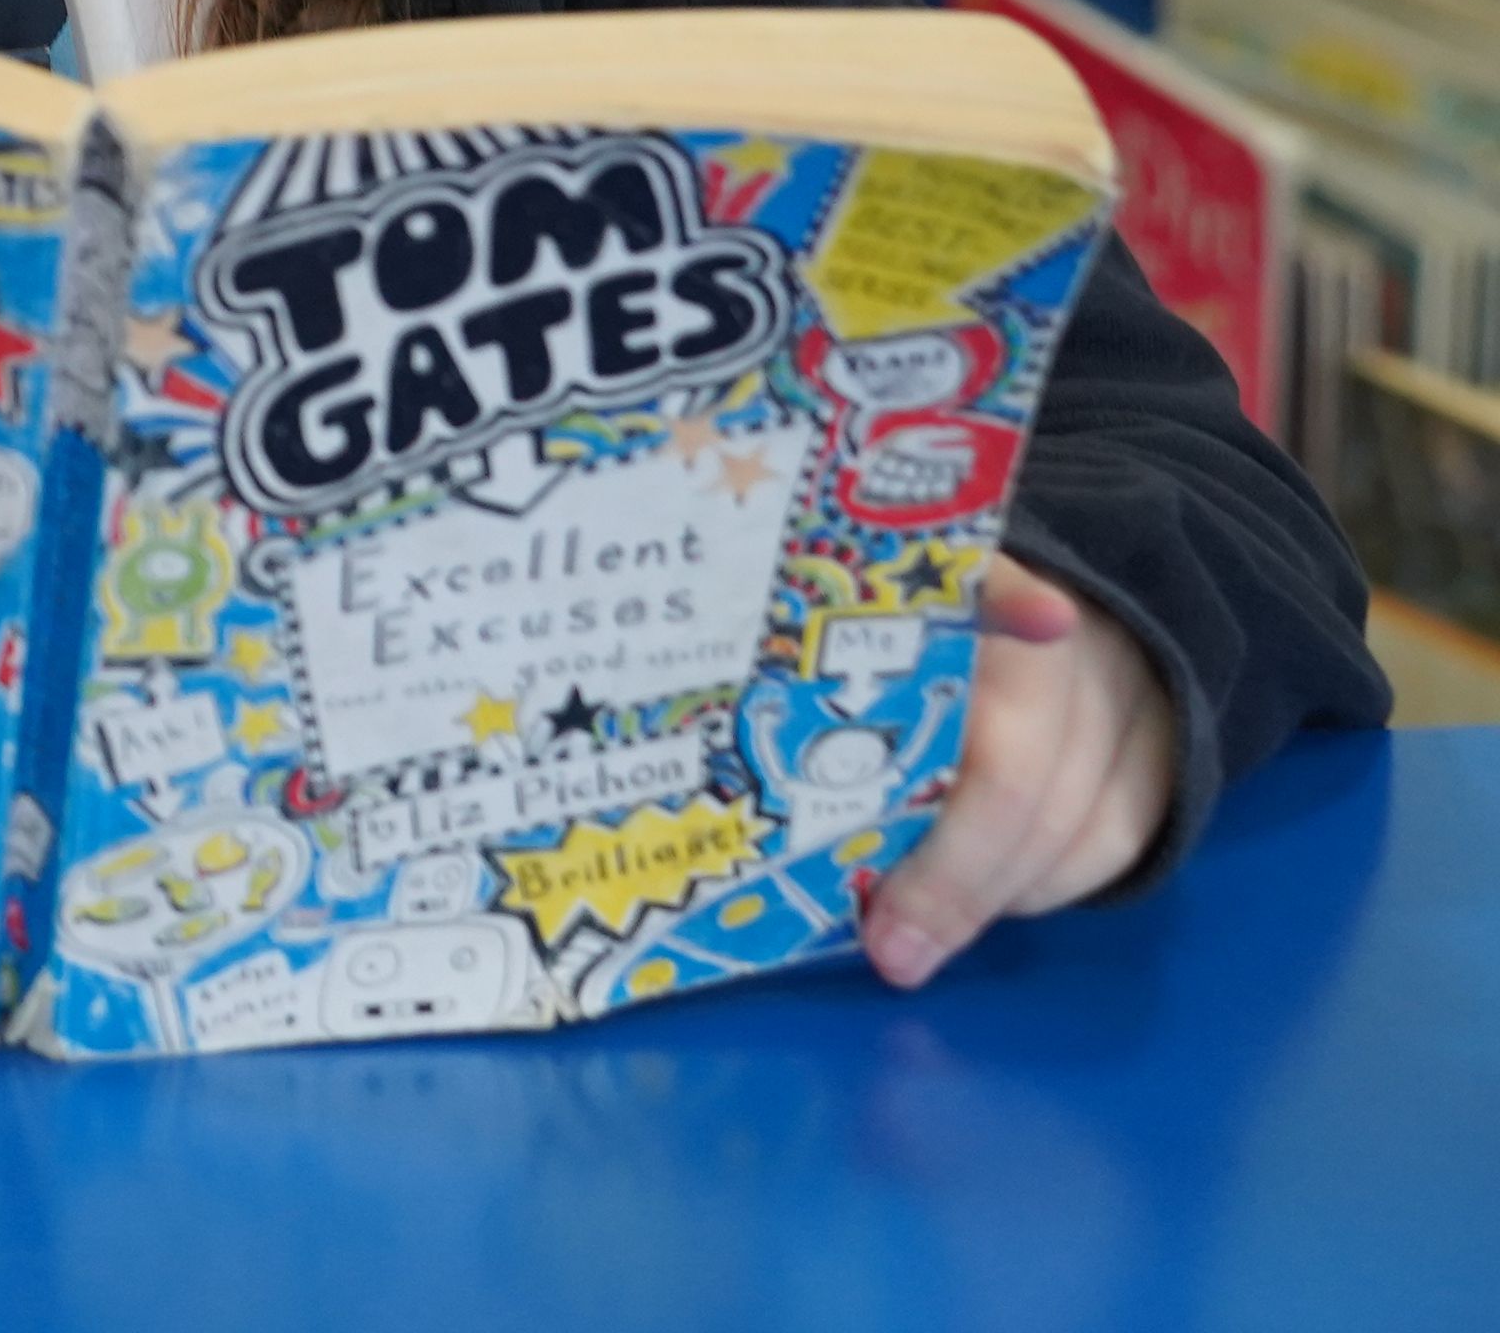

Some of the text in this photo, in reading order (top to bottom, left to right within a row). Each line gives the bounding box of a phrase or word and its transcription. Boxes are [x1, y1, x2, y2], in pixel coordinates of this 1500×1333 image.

[231, 157, 667, 354] TOM
[258, 251, 762, 491] GATES
[340, 521, 705, 615] Excellent
[372, 585, 696, 669] Excuses
[512, 639, 628, 696] good
[407, 799, 486, 841] Liz
[512, 756, 687, 816] Pichon
[515, 817, 749, 901] Brilliant!
